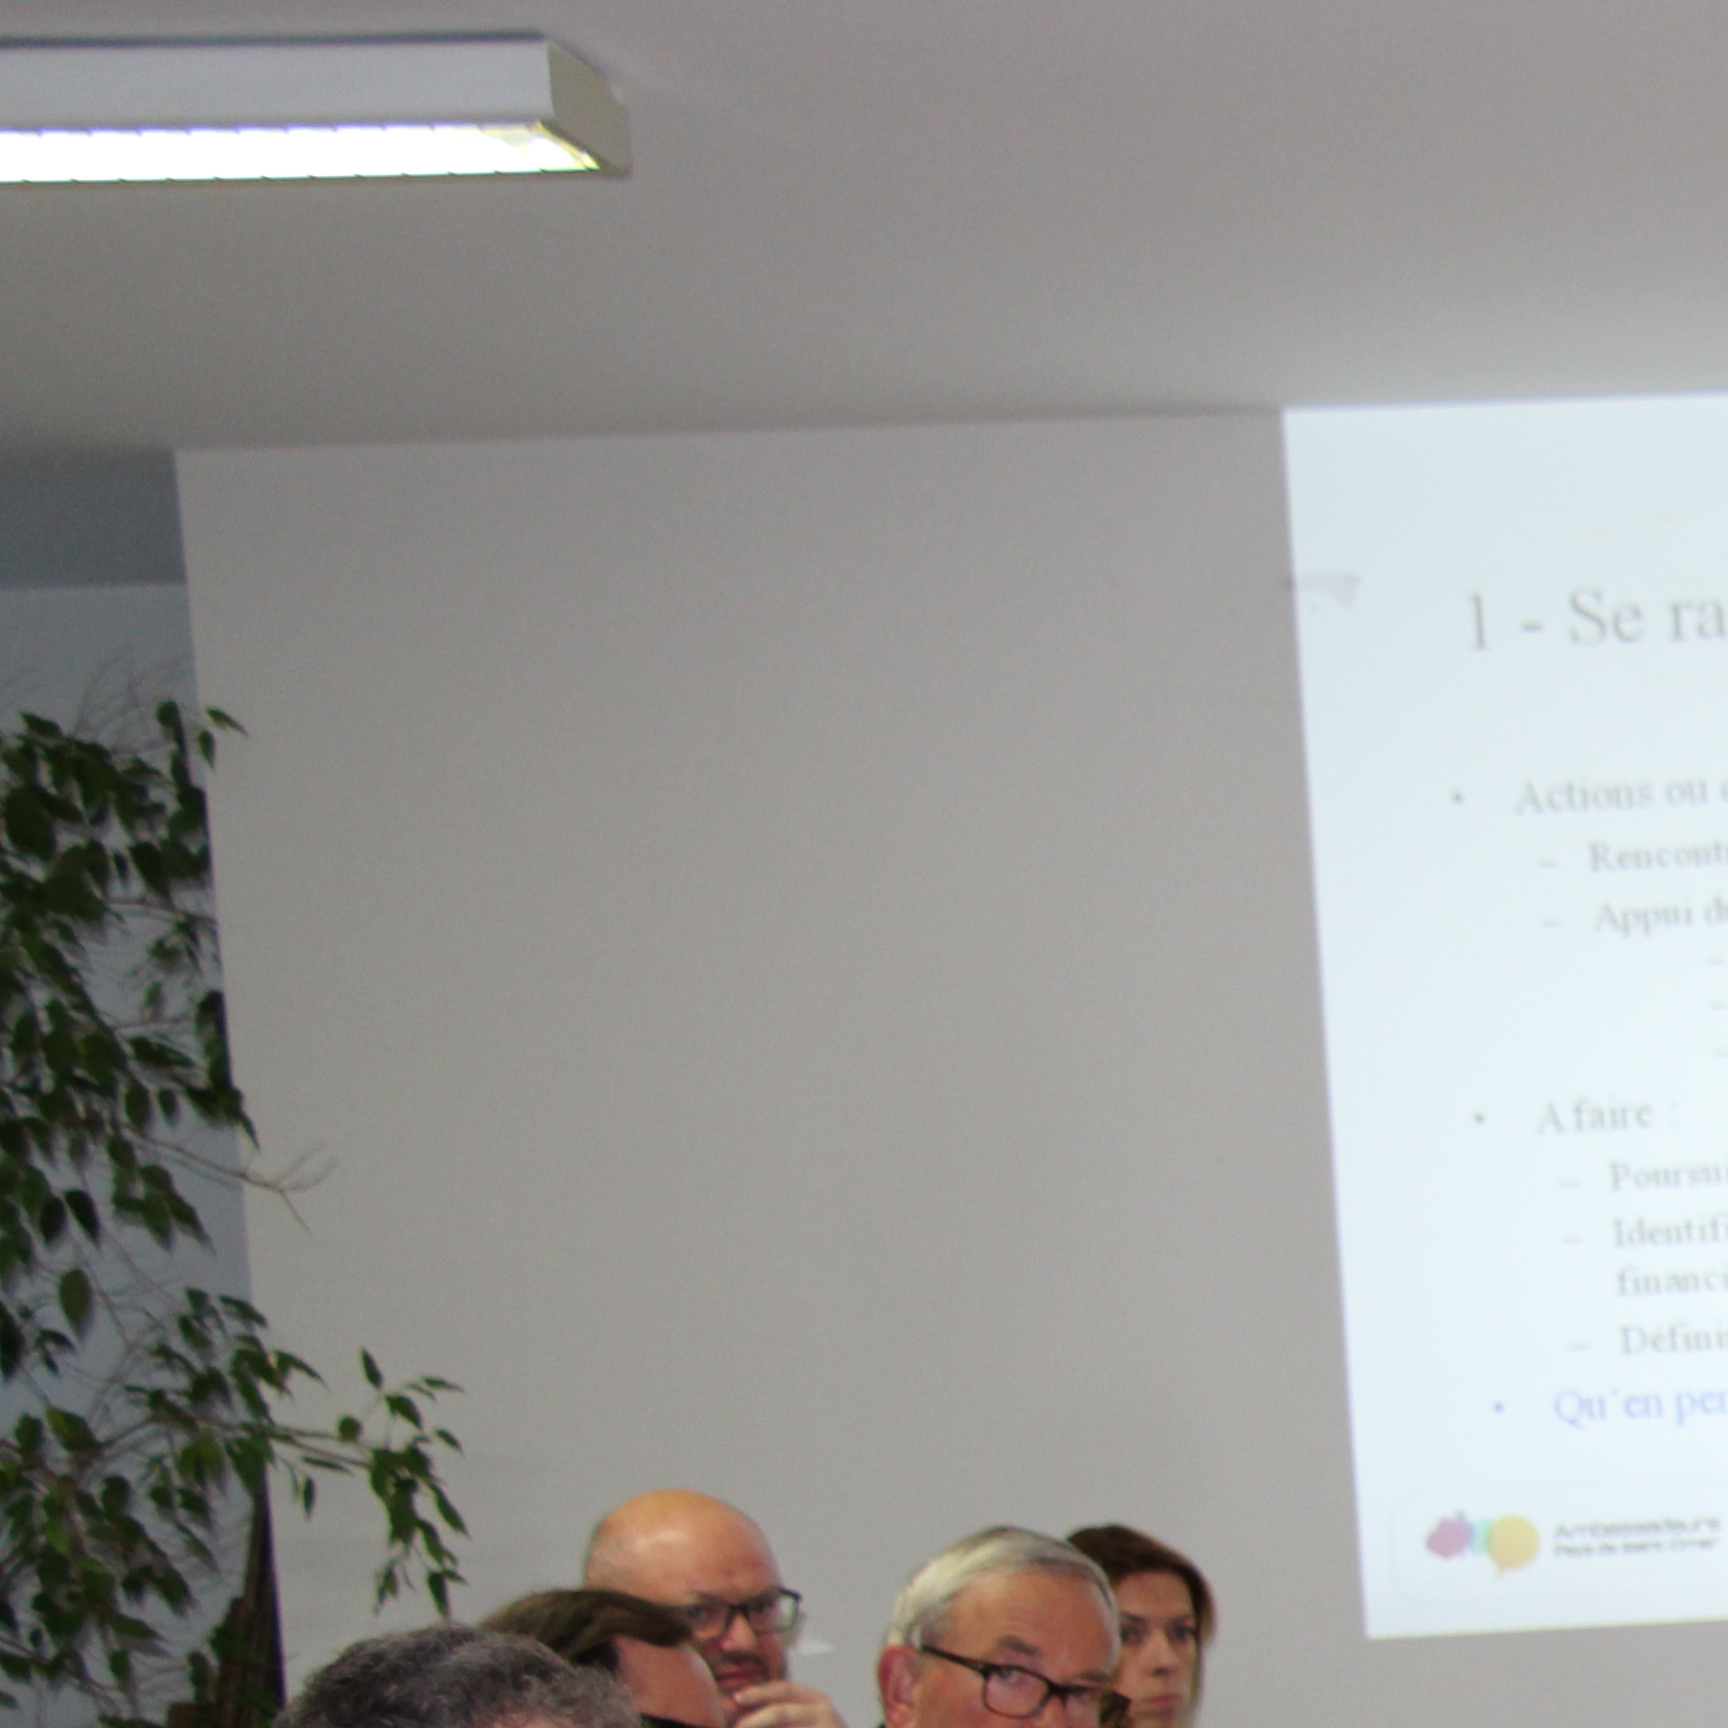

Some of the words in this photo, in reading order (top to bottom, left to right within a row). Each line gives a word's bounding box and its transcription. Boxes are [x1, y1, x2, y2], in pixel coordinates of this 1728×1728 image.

[1468, 590, 1487, 651] 1
[1566, 585, 1644, 646] Se
[1512, 776, 1654, 815] Actions
[1664, 777, 1709, 805] ou
[1594, 898, 1693, 937] Appui
[1535, 1101, 1566, 1136] A
[1572, 1097, 1654, 1135] faire
